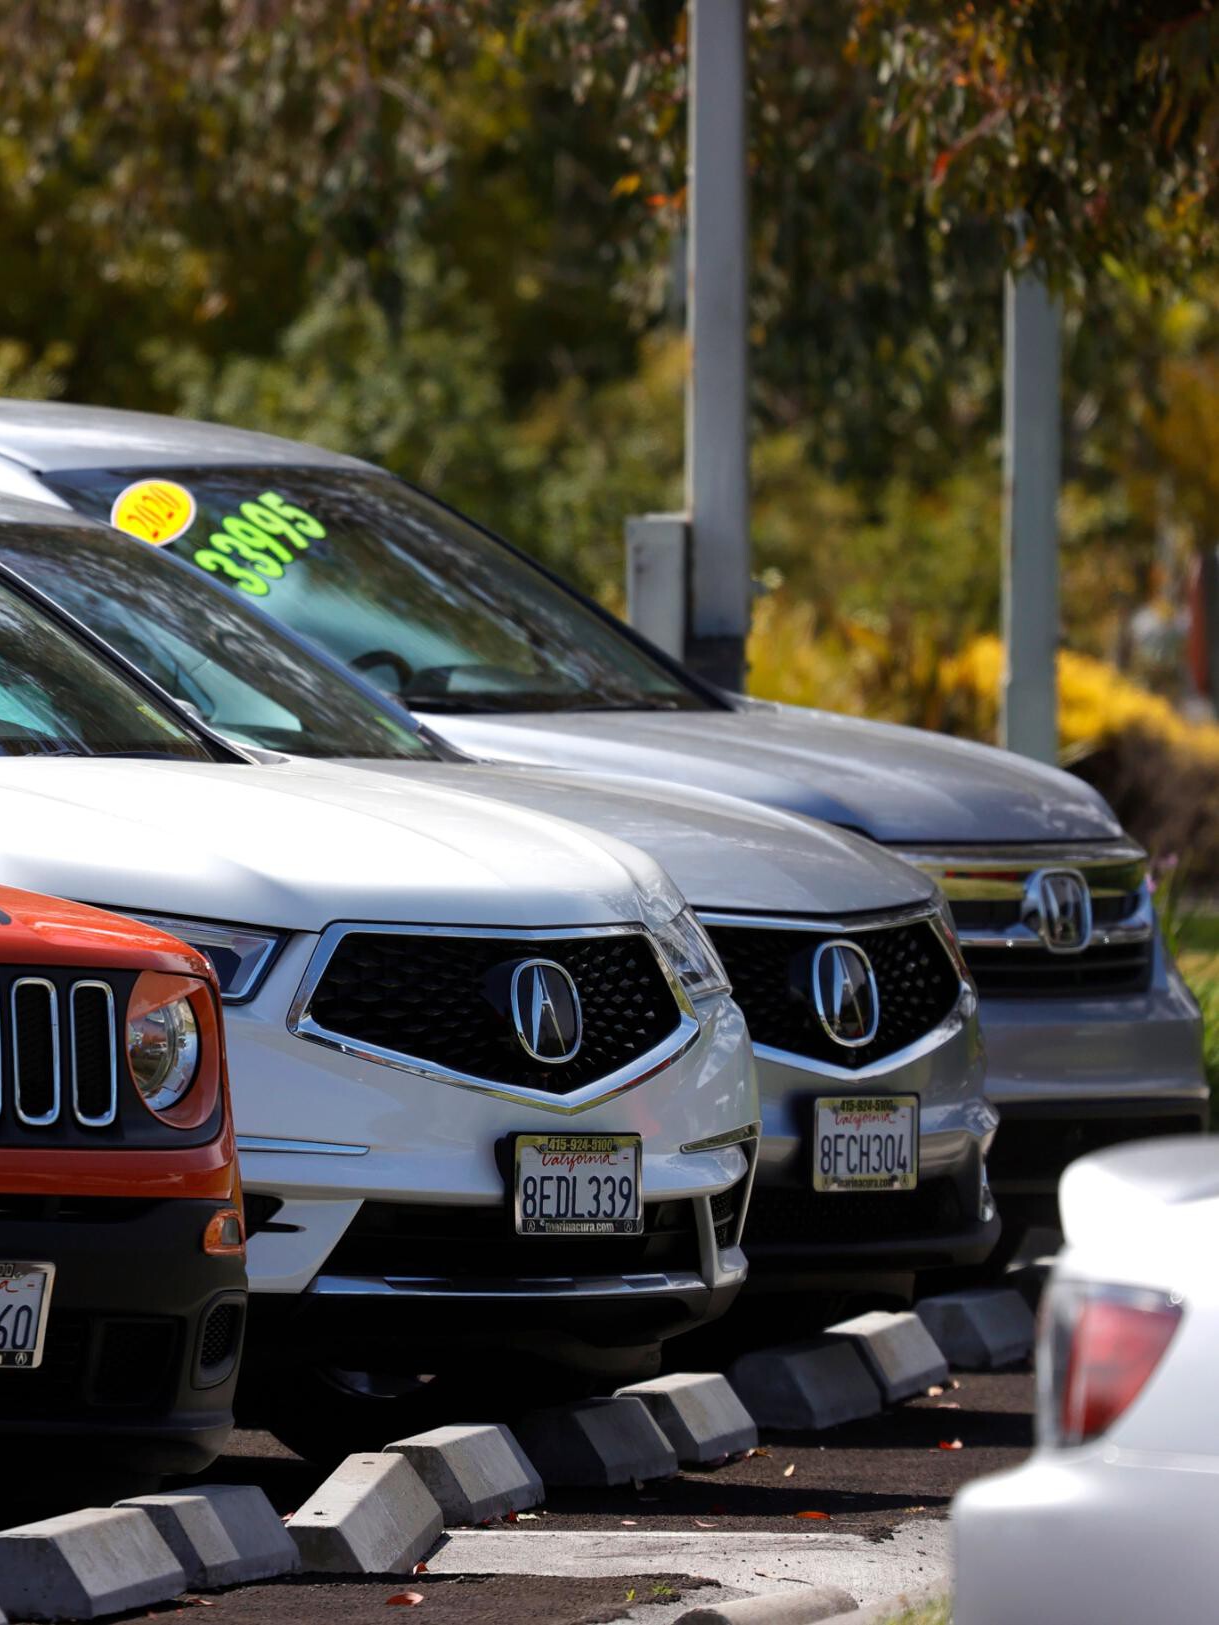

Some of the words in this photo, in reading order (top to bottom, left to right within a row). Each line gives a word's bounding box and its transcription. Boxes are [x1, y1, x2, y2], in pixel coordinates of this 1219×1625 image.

[126, 485, 181, 539] 2020
[193, 490, 327, 597] 33995
[541, 1152, 618, 1172] California
[820, 1134, 908, 1175] 8FCH304
[522, 1175, 632, 1218] 8EDL339
